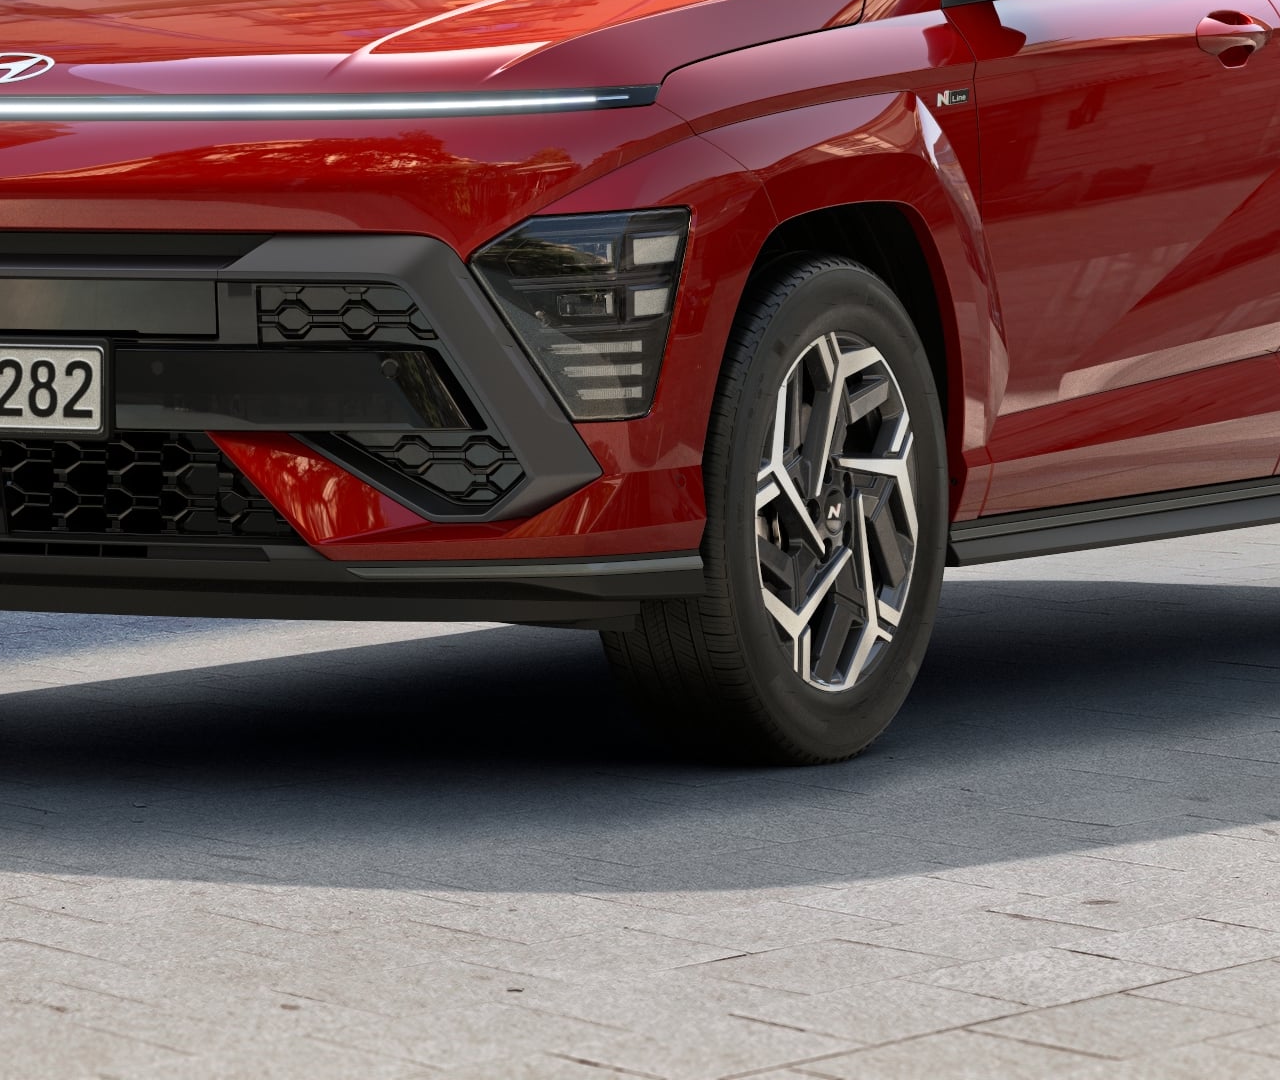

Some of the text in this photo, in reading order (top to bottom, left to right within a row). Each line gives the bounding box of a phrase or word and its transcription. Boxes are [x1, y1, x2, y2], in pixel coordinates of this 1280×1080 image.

[936, 89, 967, 107] N Line
[827, 502, 842, 519] N
